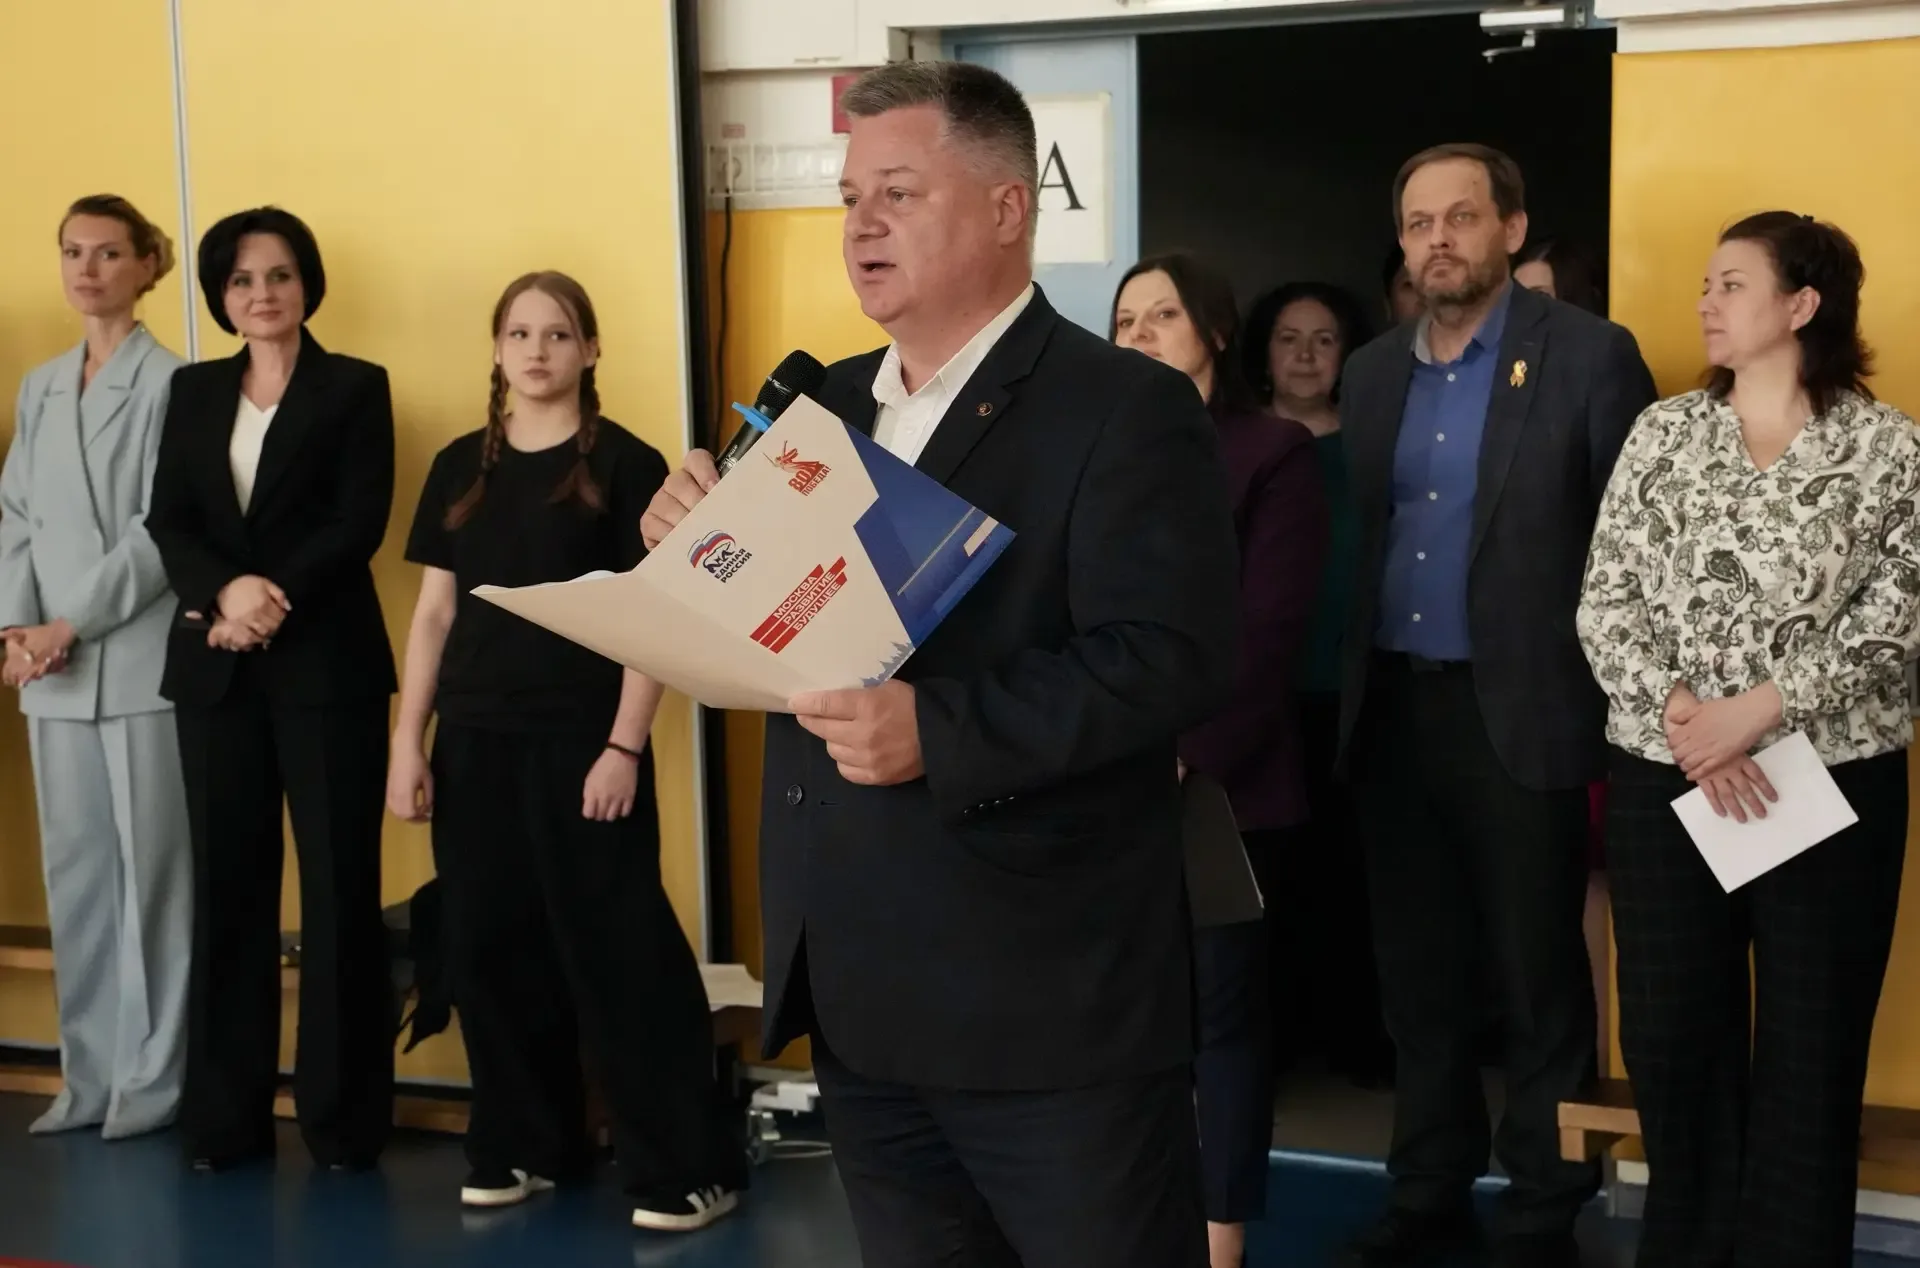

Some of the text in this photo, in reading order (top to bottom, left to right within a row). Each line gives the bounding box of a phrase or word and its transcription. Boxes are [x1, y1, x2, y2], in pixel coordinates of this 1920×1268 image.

[801, 465, 832, 496] ПОБЕДА!
[714, 548, 746, 579] ЕДИНАЯ
[720, 552, 753, 583] РОССИЯ
[773, 576, 817, 619] МОСКВА
[783, 572, 836, 625] РАЗВИТИЕ
[792, 581, 841, 631] БУДУЩЕЕ
